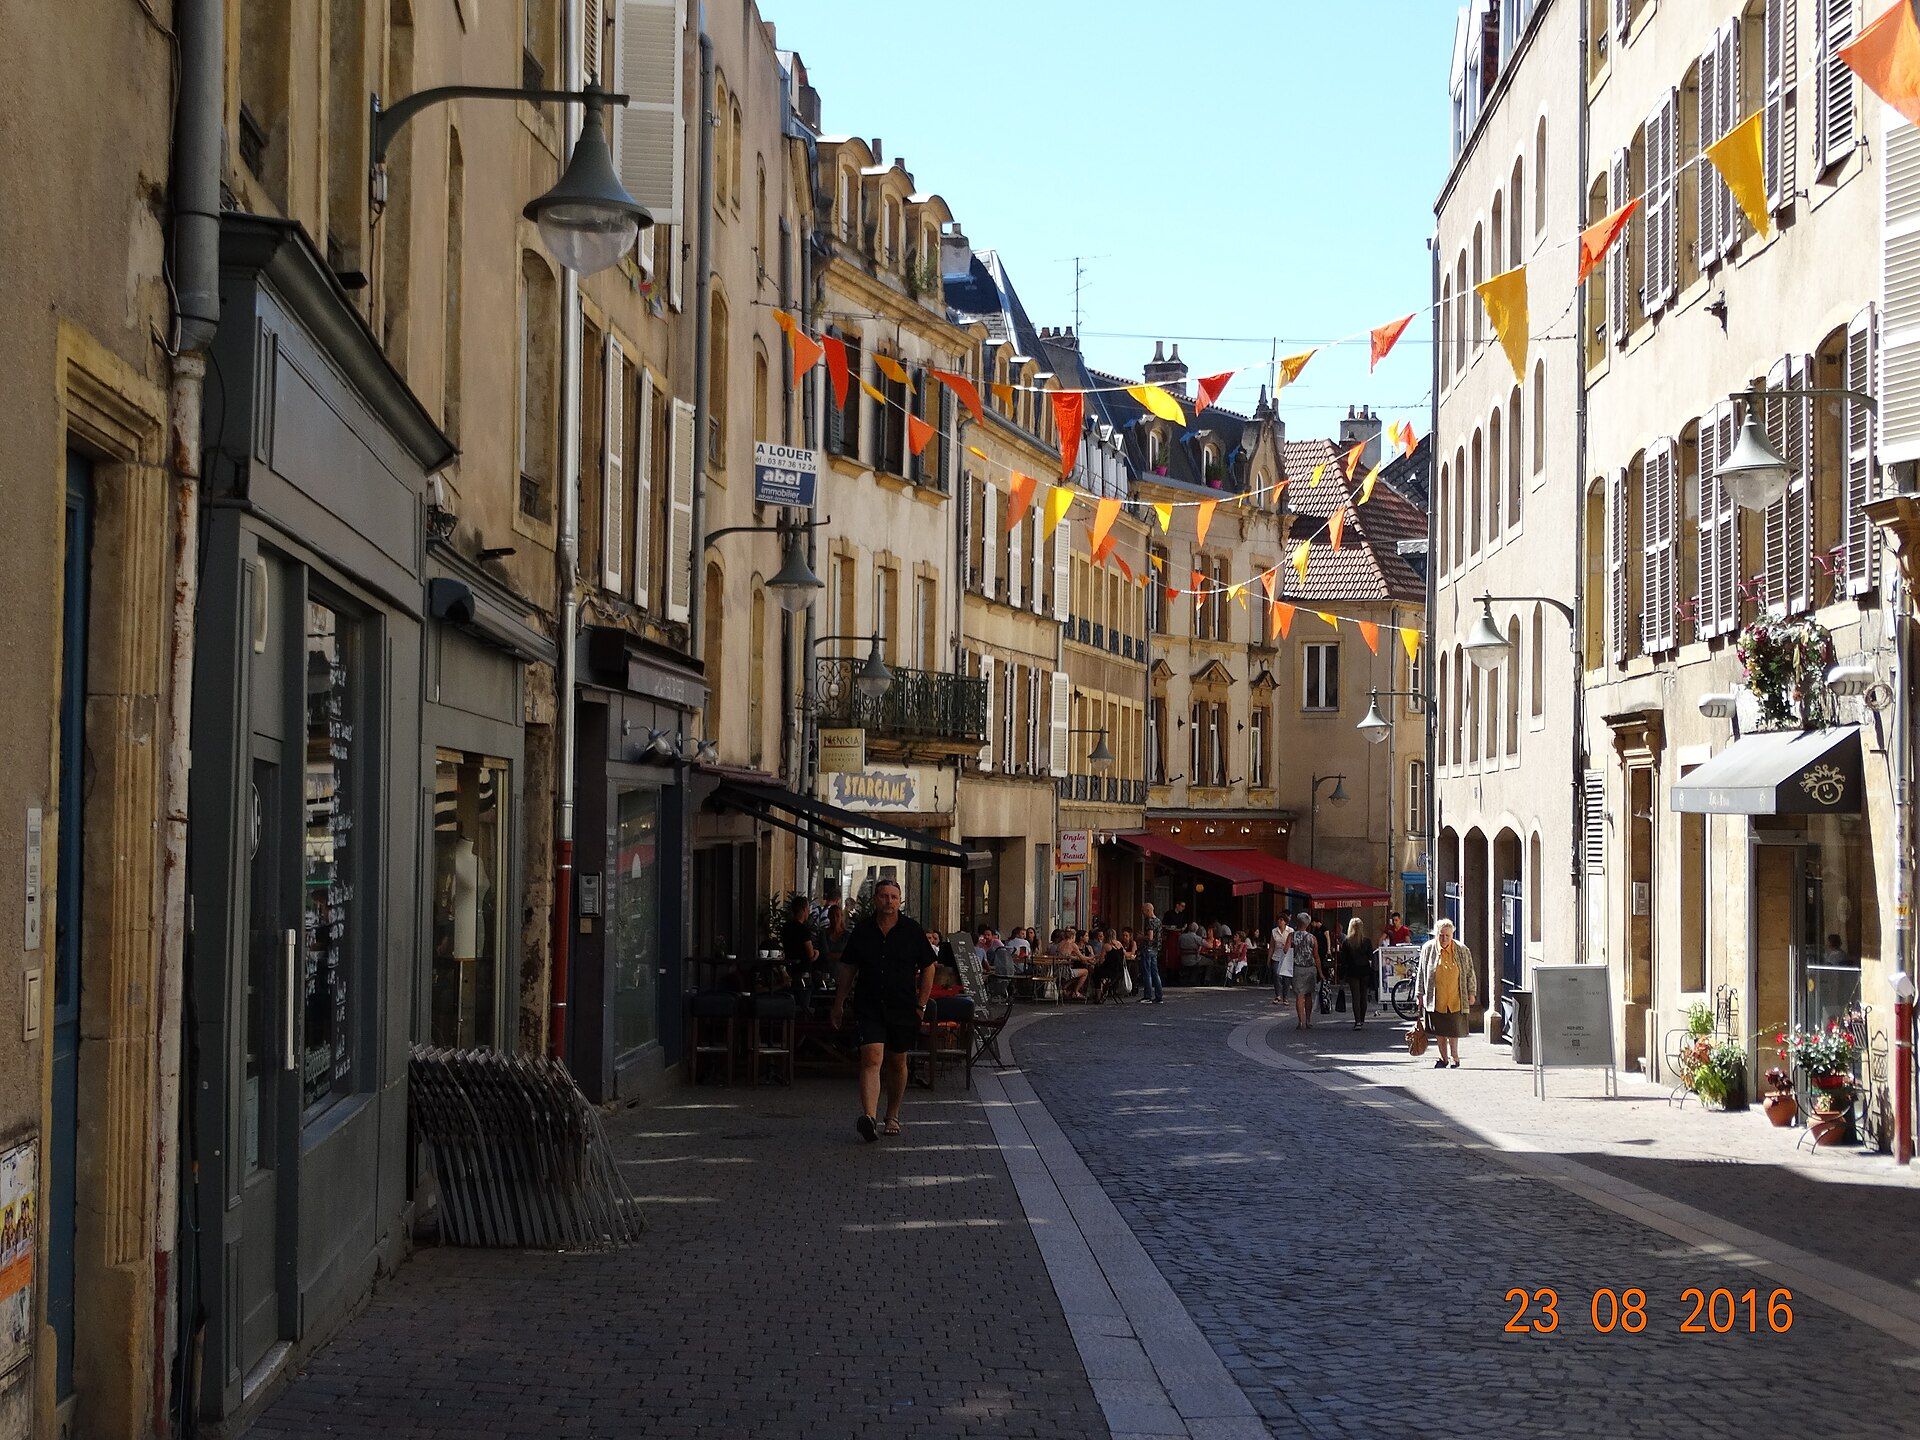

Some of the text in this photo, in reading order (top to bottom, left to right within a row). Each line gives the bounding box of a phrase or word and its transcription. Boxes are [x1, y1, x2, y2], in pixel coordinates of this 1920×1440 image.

[756, 444, 812, 462] A LOUER
[768, 457, 776, 465] 03
[763, 469, 801, 485] abel
[761, 486, 800, 499] immobilier
[844, 775, 906, 801] STARGAME
[1063, 834, 1086, 842] Ongles
